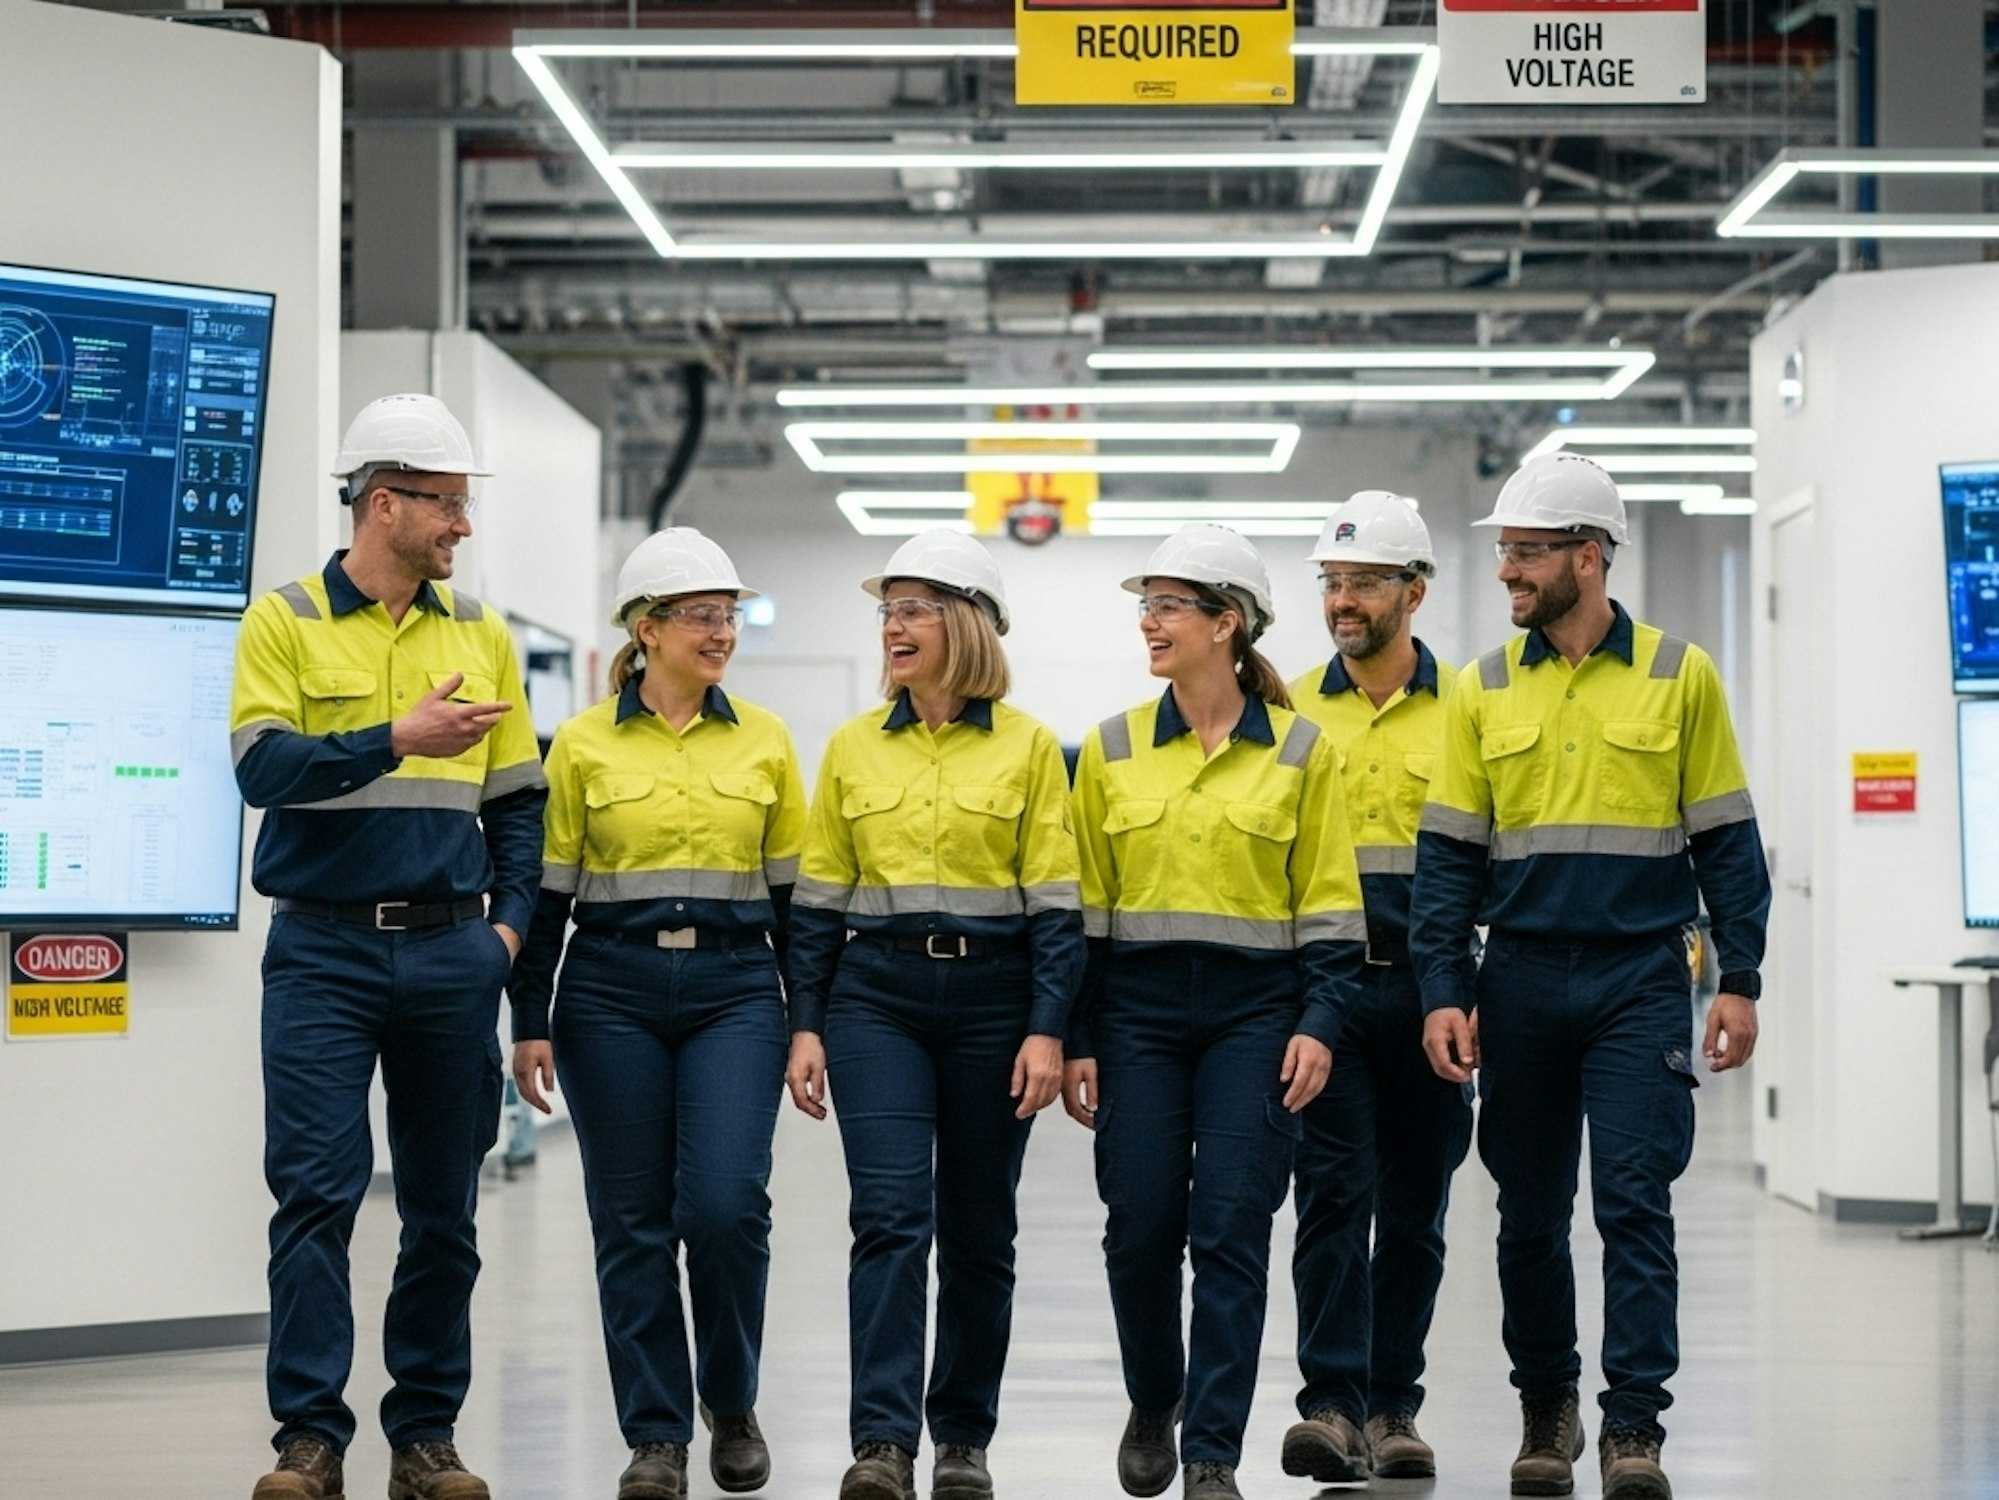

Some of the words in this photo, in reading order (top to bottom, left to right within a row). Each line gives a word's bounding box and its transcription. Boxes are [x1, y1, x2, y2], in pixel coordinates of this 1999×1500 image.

[1076, 24, 1240, 61] REQUIRED
[1534, 22, 1603, 51] HIGH
[1505, 58, 1635, 87] VOLTAGE
